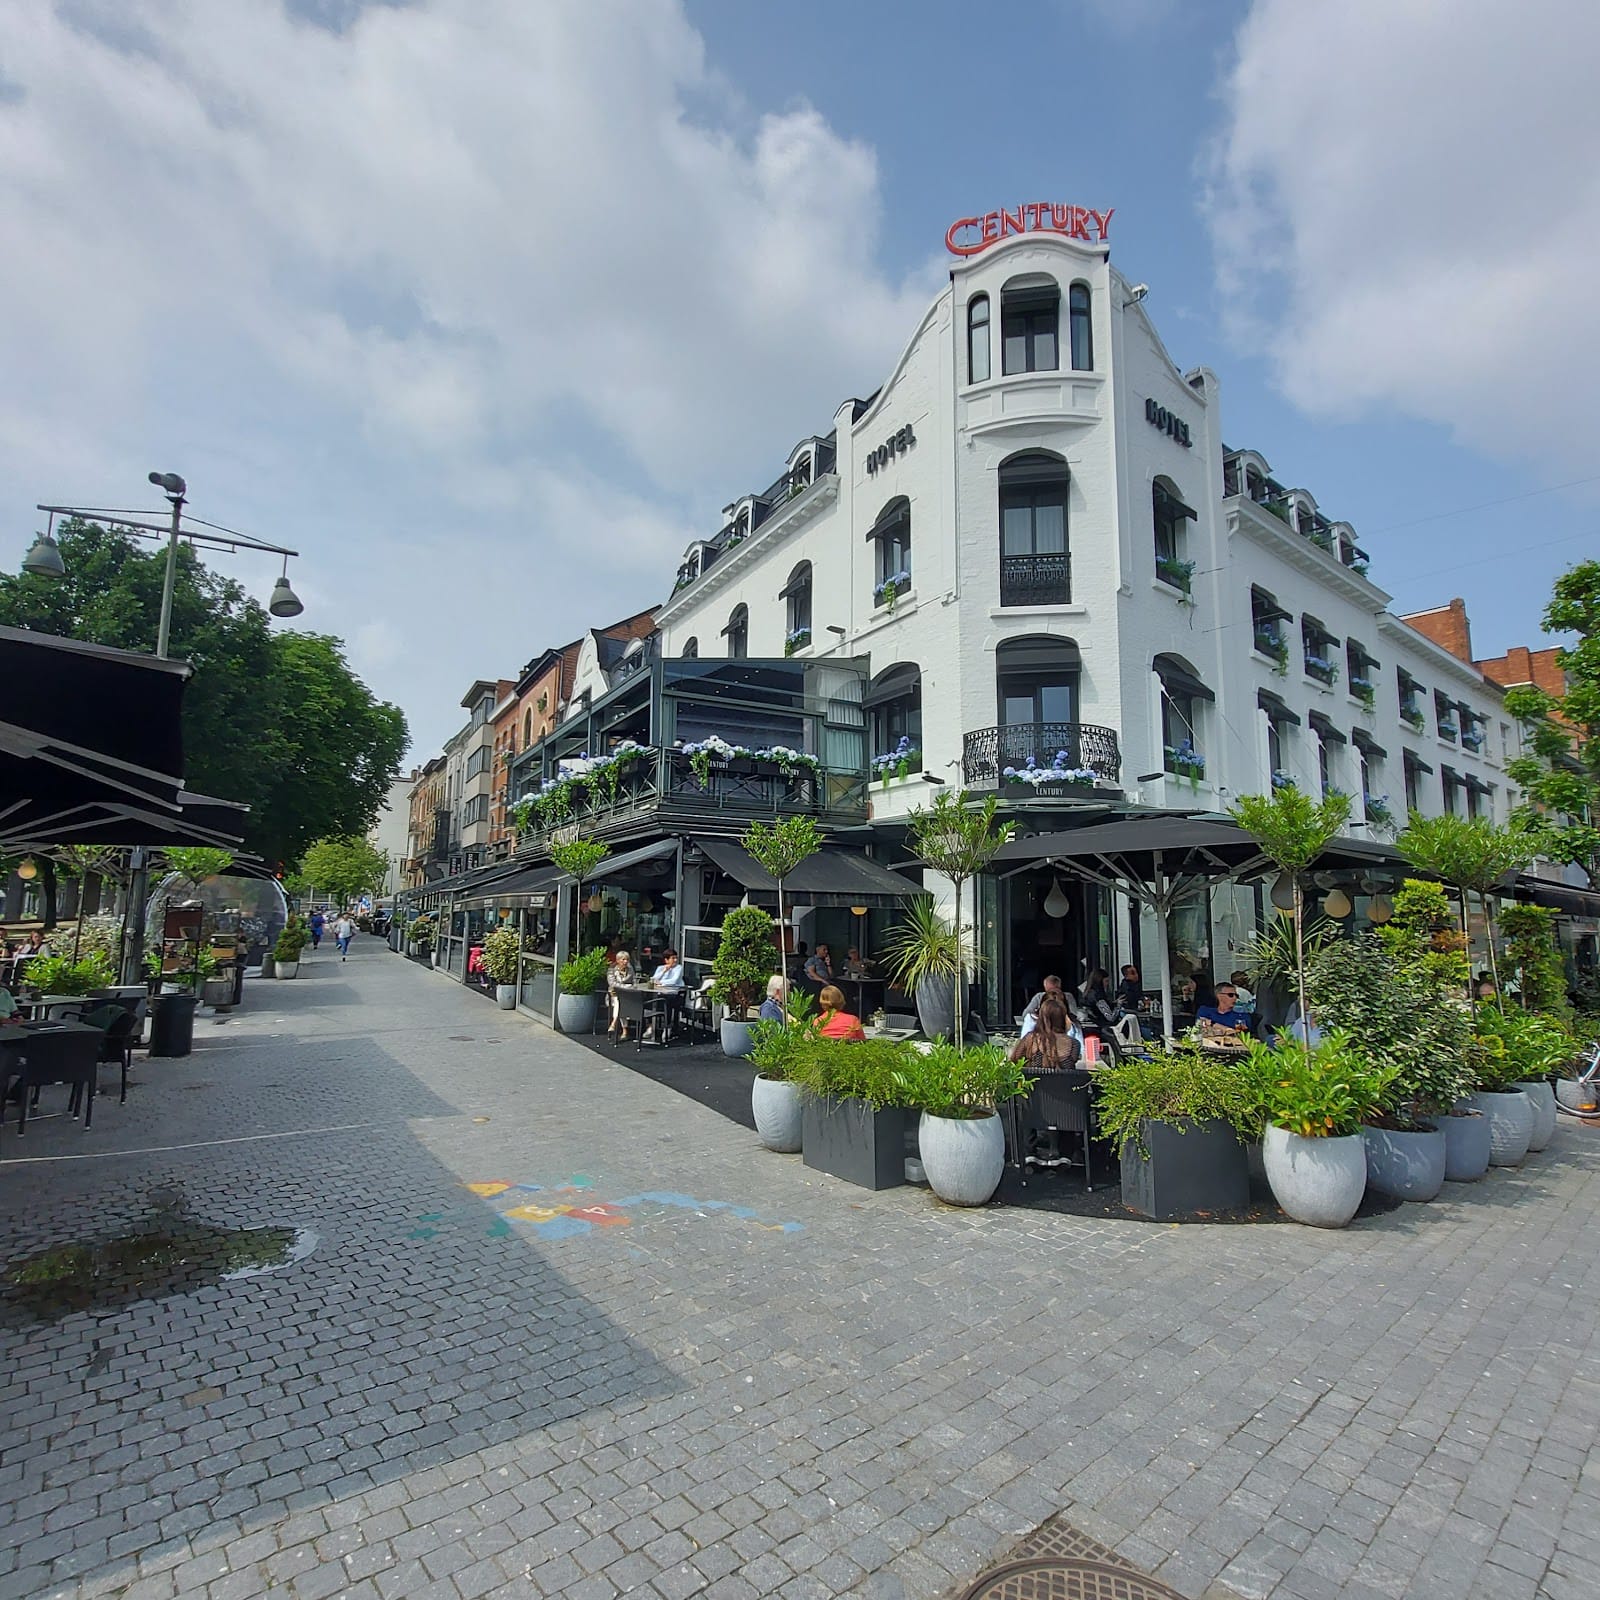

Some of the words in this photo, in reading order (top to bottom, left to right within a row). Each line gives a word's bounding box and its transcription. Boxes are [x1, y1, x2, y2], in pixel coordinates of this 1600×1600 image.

[945, 201, 1116, 256] CENTURY
[1145, 398, 1193, 448] HOTEL
[867, 424, 917, 475] HOTEL
[1035, 786, 1064, 797] CENTURY
